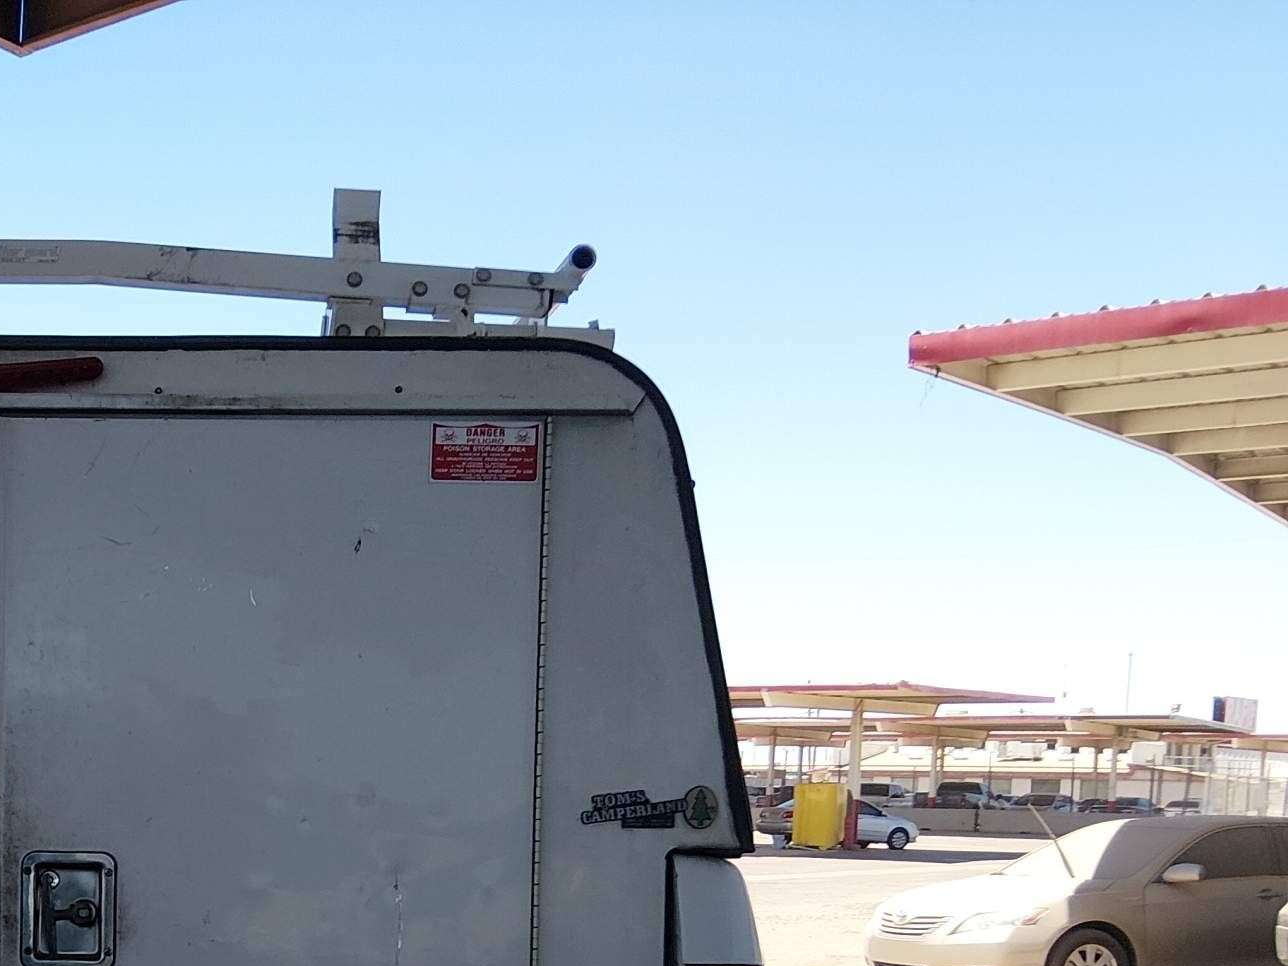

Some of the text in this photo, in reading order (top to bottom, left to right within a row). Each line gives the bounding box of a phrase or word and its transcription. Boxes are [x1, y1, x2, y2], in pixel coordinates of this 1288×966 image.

[466, 428, 505, 437] DANGER
[472, 445, 505, 453] STORAGE
[592, 790, 647, 808] TOM'S
[581, 799, 688, 824] CAMPERLAND
